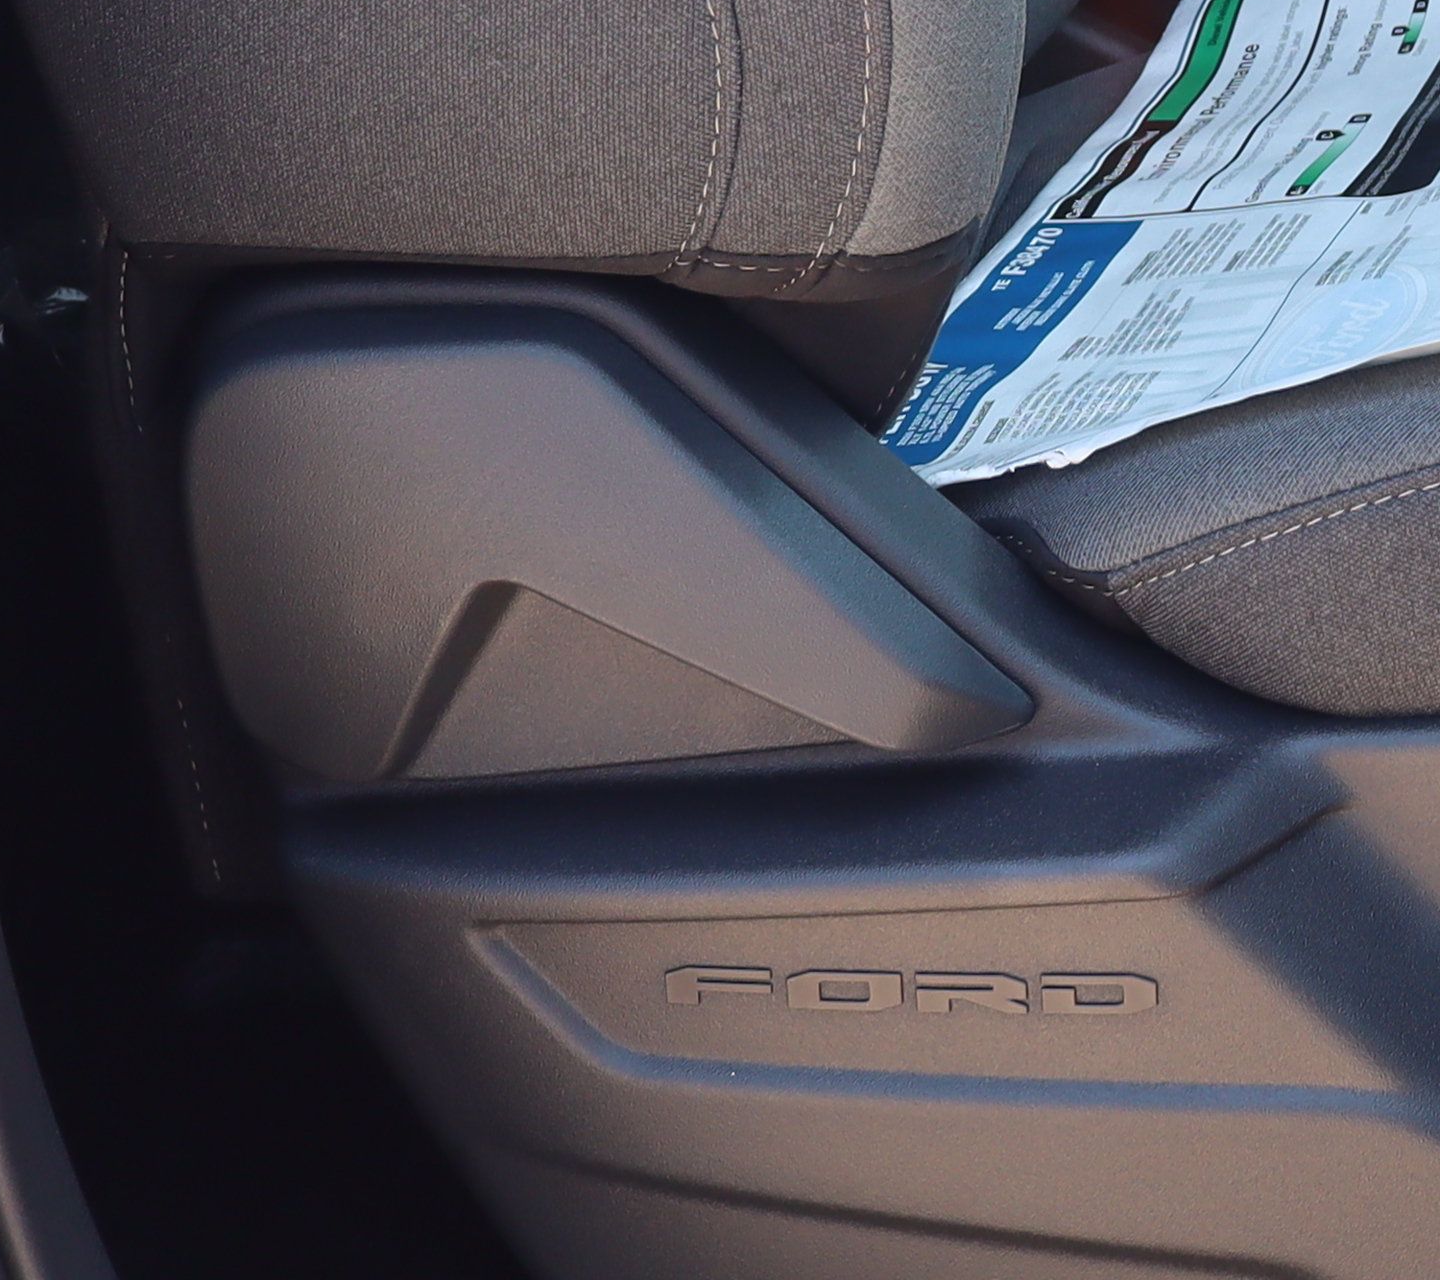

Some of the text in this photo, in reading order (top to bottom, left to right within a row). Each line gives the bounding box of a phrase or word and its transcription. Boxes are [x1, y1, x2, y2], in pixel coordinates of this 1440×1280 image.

[1313, 42, 1338, 70] higher
[1138, 43, 1262, 180] Environmental Performance
[999, 226, 1066, 274] F38470
[665, 963, 1158, 1014] FORD
